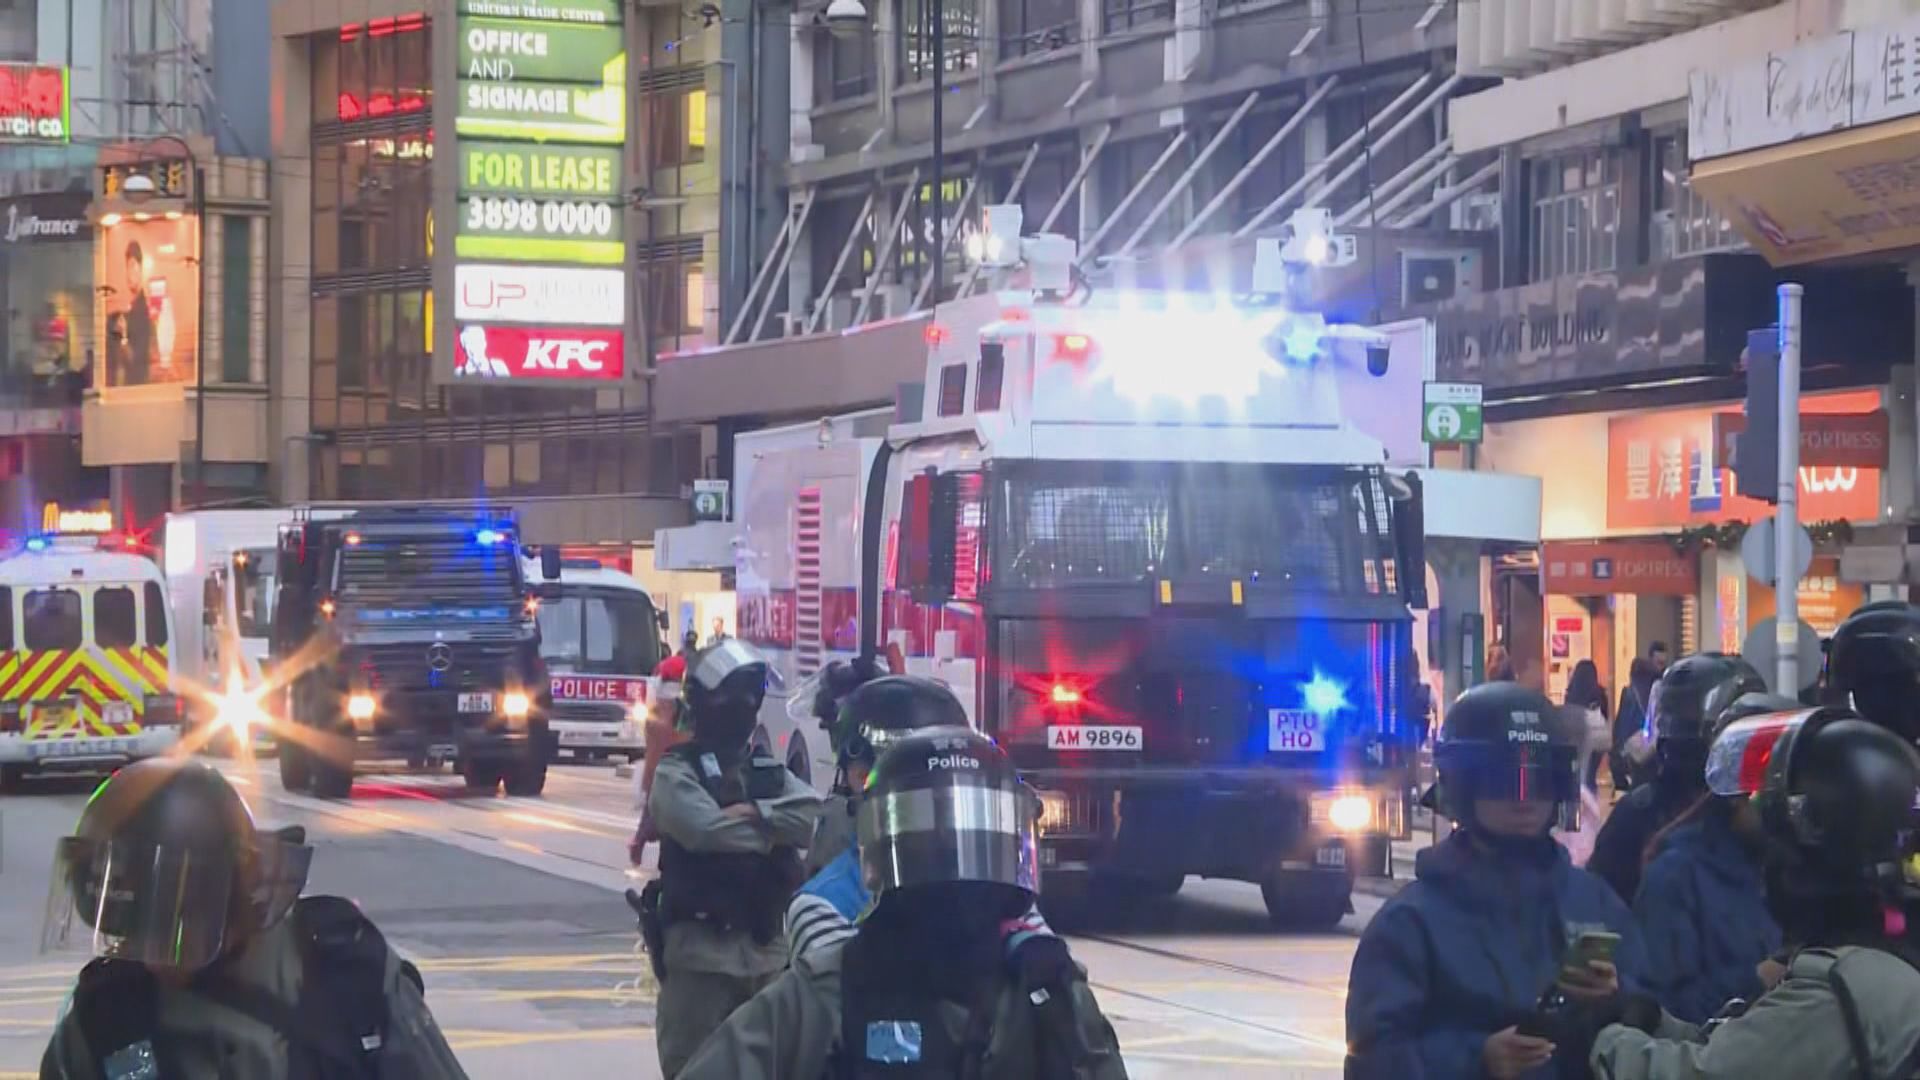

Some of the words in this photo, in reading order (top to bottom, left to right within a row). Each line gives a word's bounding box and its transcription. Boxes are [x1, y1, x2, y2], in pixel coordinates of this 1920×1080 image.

[468, 2, 519, 16] UNICORN
[468, 28, 548, 56] OFFICE
[468, 57, 513, 80] AND
[468, 84, 569, 114] SIGNAGE
[469, 152, 523, 188] FOR
[530, 154, 611, 192] LEASE
[467, 196, 538, 232] 3898
[543, 200, 612, 236] 0000
[522, 339, 610, 371] KFC
[1801, 430, 1882, 450] FORTRESS
[551, 679, 617, 699] POLICE
[1277, 712, 1320, 730] PTU
[1055, 730, 1080, 746] AM
[1086, 730, 1137, 746] 9896
[1508, 730, 1548, 743] Police
[928, 754, 979, 771] Police
